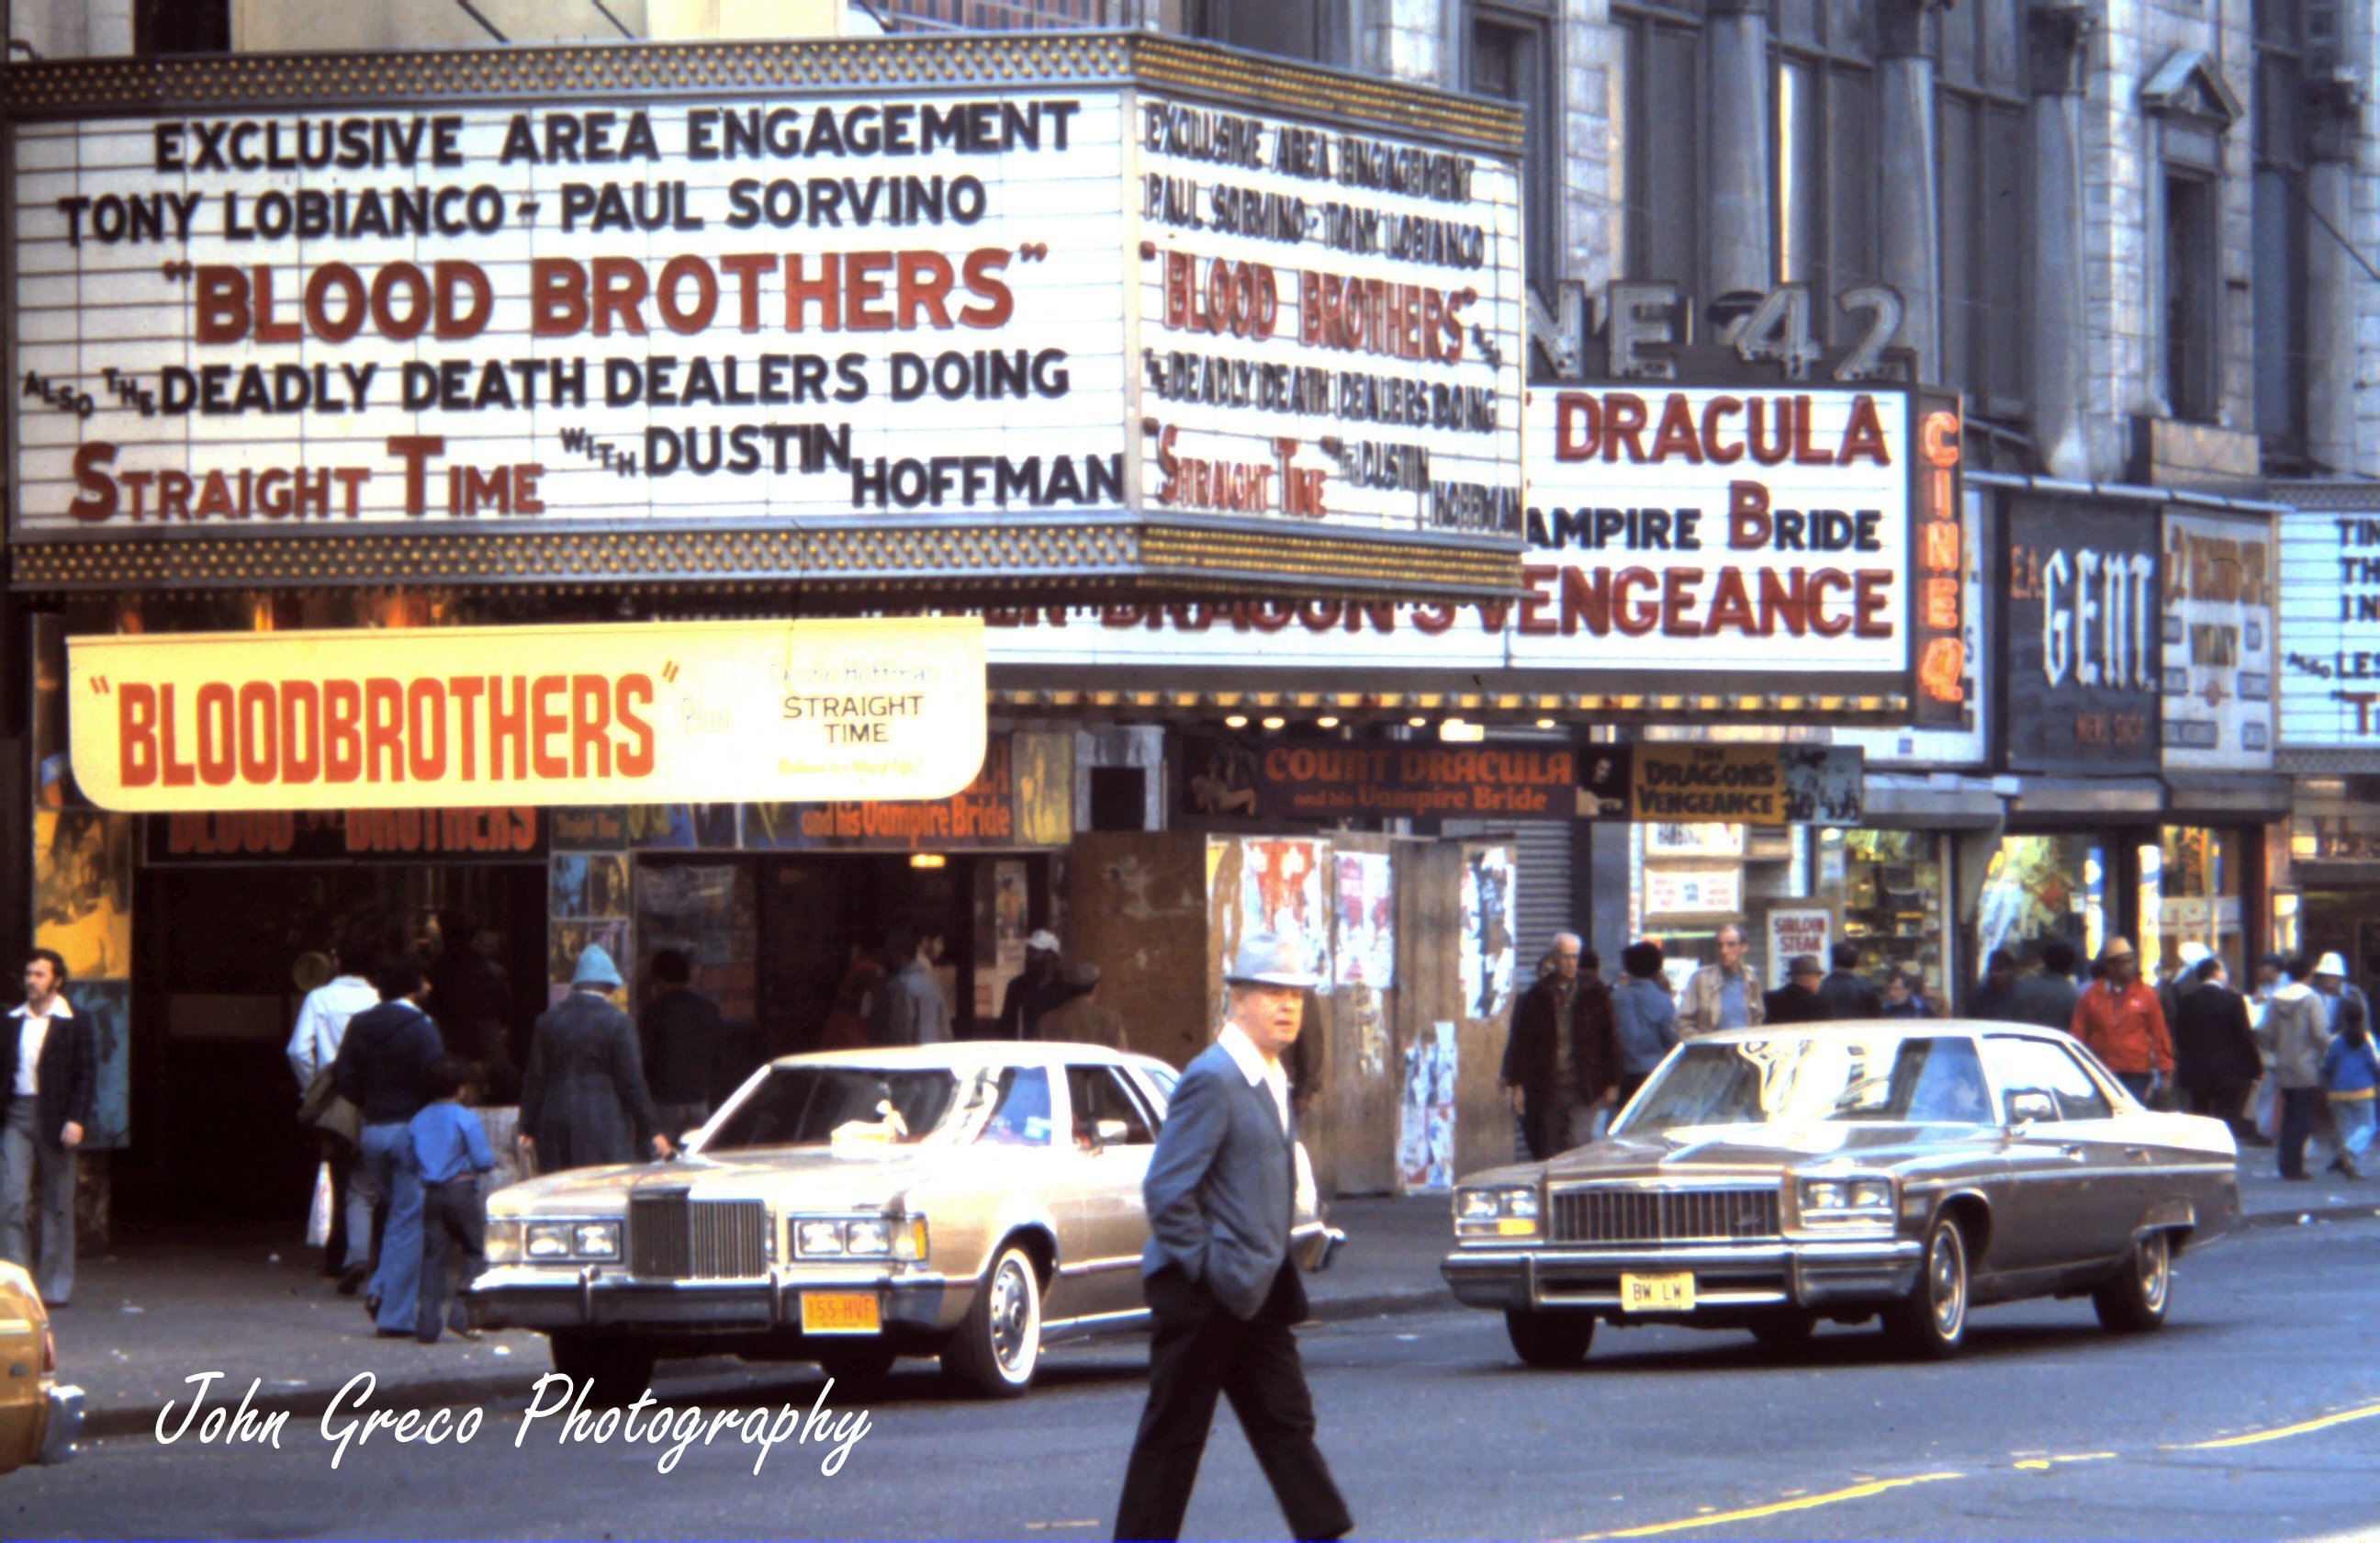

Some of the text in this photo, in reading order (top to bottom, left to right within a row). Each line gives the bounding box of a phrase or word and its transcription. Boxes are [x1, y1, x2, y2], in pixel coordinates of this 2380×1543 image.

[154, 100, 1080, 173] EXCLUSIVE AREA ENGAGEMENT
[1145, 100, 1475, 205] EXCLUSIVE AREA ENGAGEMENT
[58, 190, 201, 247] TONY
[224, 184, 505, 240] LOBIANCO
[560, 180, 703, 231] PAUL
[726, 175, 986, 230] SORVINO
[1144, 173, 1203, 229] PAUL
[1211, 183, 1306, 244] SORVINO
[1323, 202, 1381, 255] TONY
[1386, 213, 1485, 270] LOBIANCO
[23, 348, 1070, 418] ALSO THE DEADLY DEATH DEALERS DOING
[1167, 351, 1252, 409] DEADLY
[1255, 361, 1329, 416] DEATH
[1335, 370, 1429, 428] DEALERS
[1432, 382, 1496, 434] DOING
[1555, 391, 1892, 467] DRACULA
[69, 423, 1125, 521] STRAIGHT TIME WITH DUSTIN HOFFMAN
[1430, 479, 1522, 533] HOFFMAN
[1526, 480, 1881, 552] AMPIRE BRIDE
[783, 695, 924, 719] STRAIGHT
[824, 723, 889, 744] TIME
[1264, 748, 1572, 785] COUNT DRACULA
[1358, 784, 1468, 817] Vampire
[1473, 786, 1548, 811] Bride
[1637, 785, 1773, 815] VENGEANCE
[862, 799, 949, 850] Vampire
[950, 795, 1010, 838] Bride
[1779, 936, 1822, 952] STEAK
